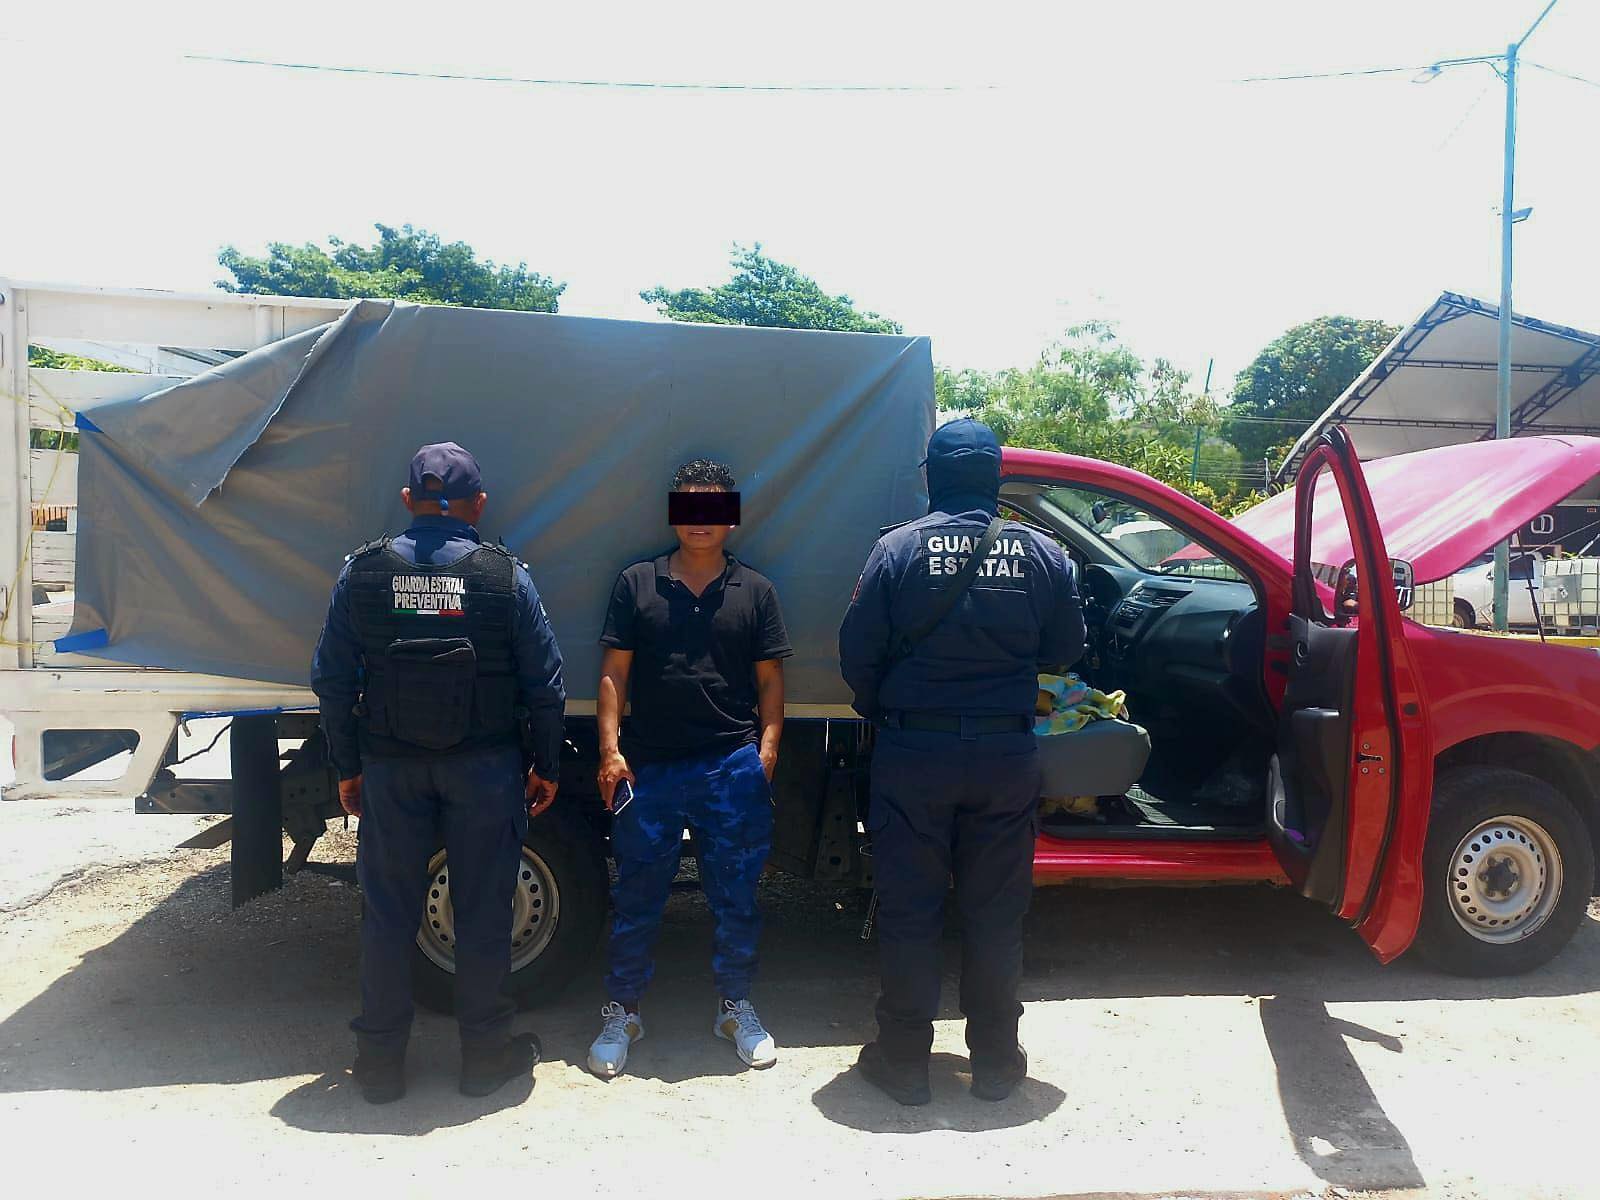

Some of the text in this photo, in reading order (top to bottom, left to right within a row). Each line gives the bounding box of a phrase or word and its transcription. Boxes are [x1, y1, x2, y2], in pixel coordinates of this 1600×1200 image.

[393, 575, 465, 594] GUARDIA ESTATAL
[395, 593, 462, 609] PREVENTIVA
